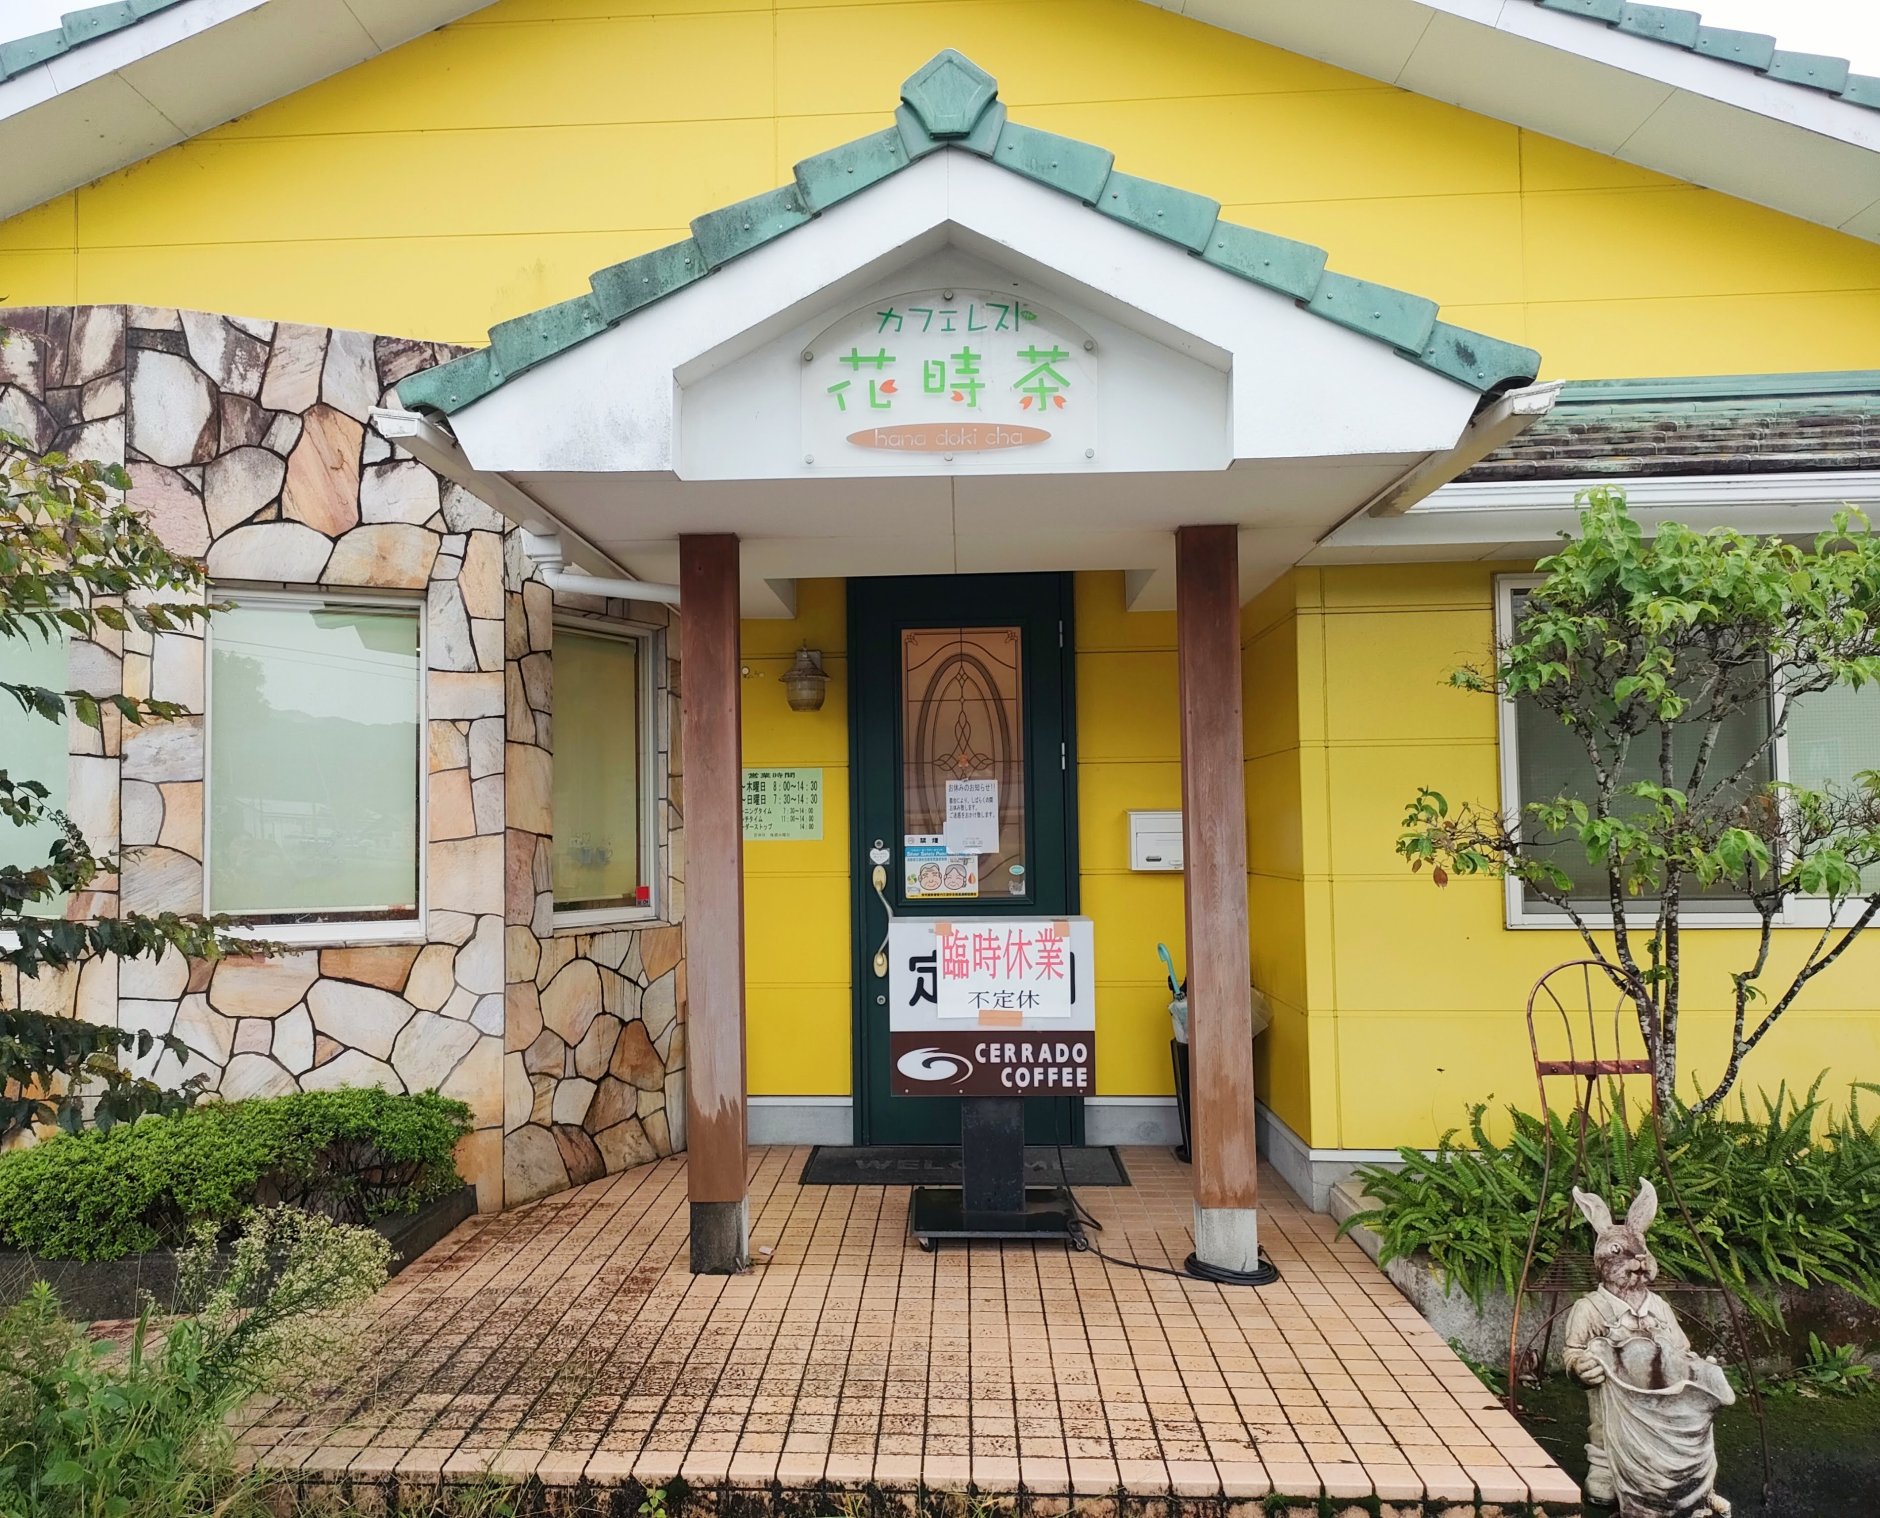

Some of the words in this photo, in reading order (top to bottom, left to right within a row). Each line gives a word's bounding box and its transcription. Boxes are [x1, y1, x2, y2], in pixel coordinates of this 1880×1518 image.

[876, 301, 1037, 334] カフェレスト
[827, 345, 1071, 411] 花時茶
[874, 428, 927, 447] hana
[935, 428, 978, 447] doki
[985, 427, 1024, 446] cha
[942, 928, 1064, 981] 臨時休業
[968, 990, 1040, 1009] 不定休
[974, 1042, 1088, 1064] CERRADO
[1001, 1066, 1088, 1088] COFFEE
